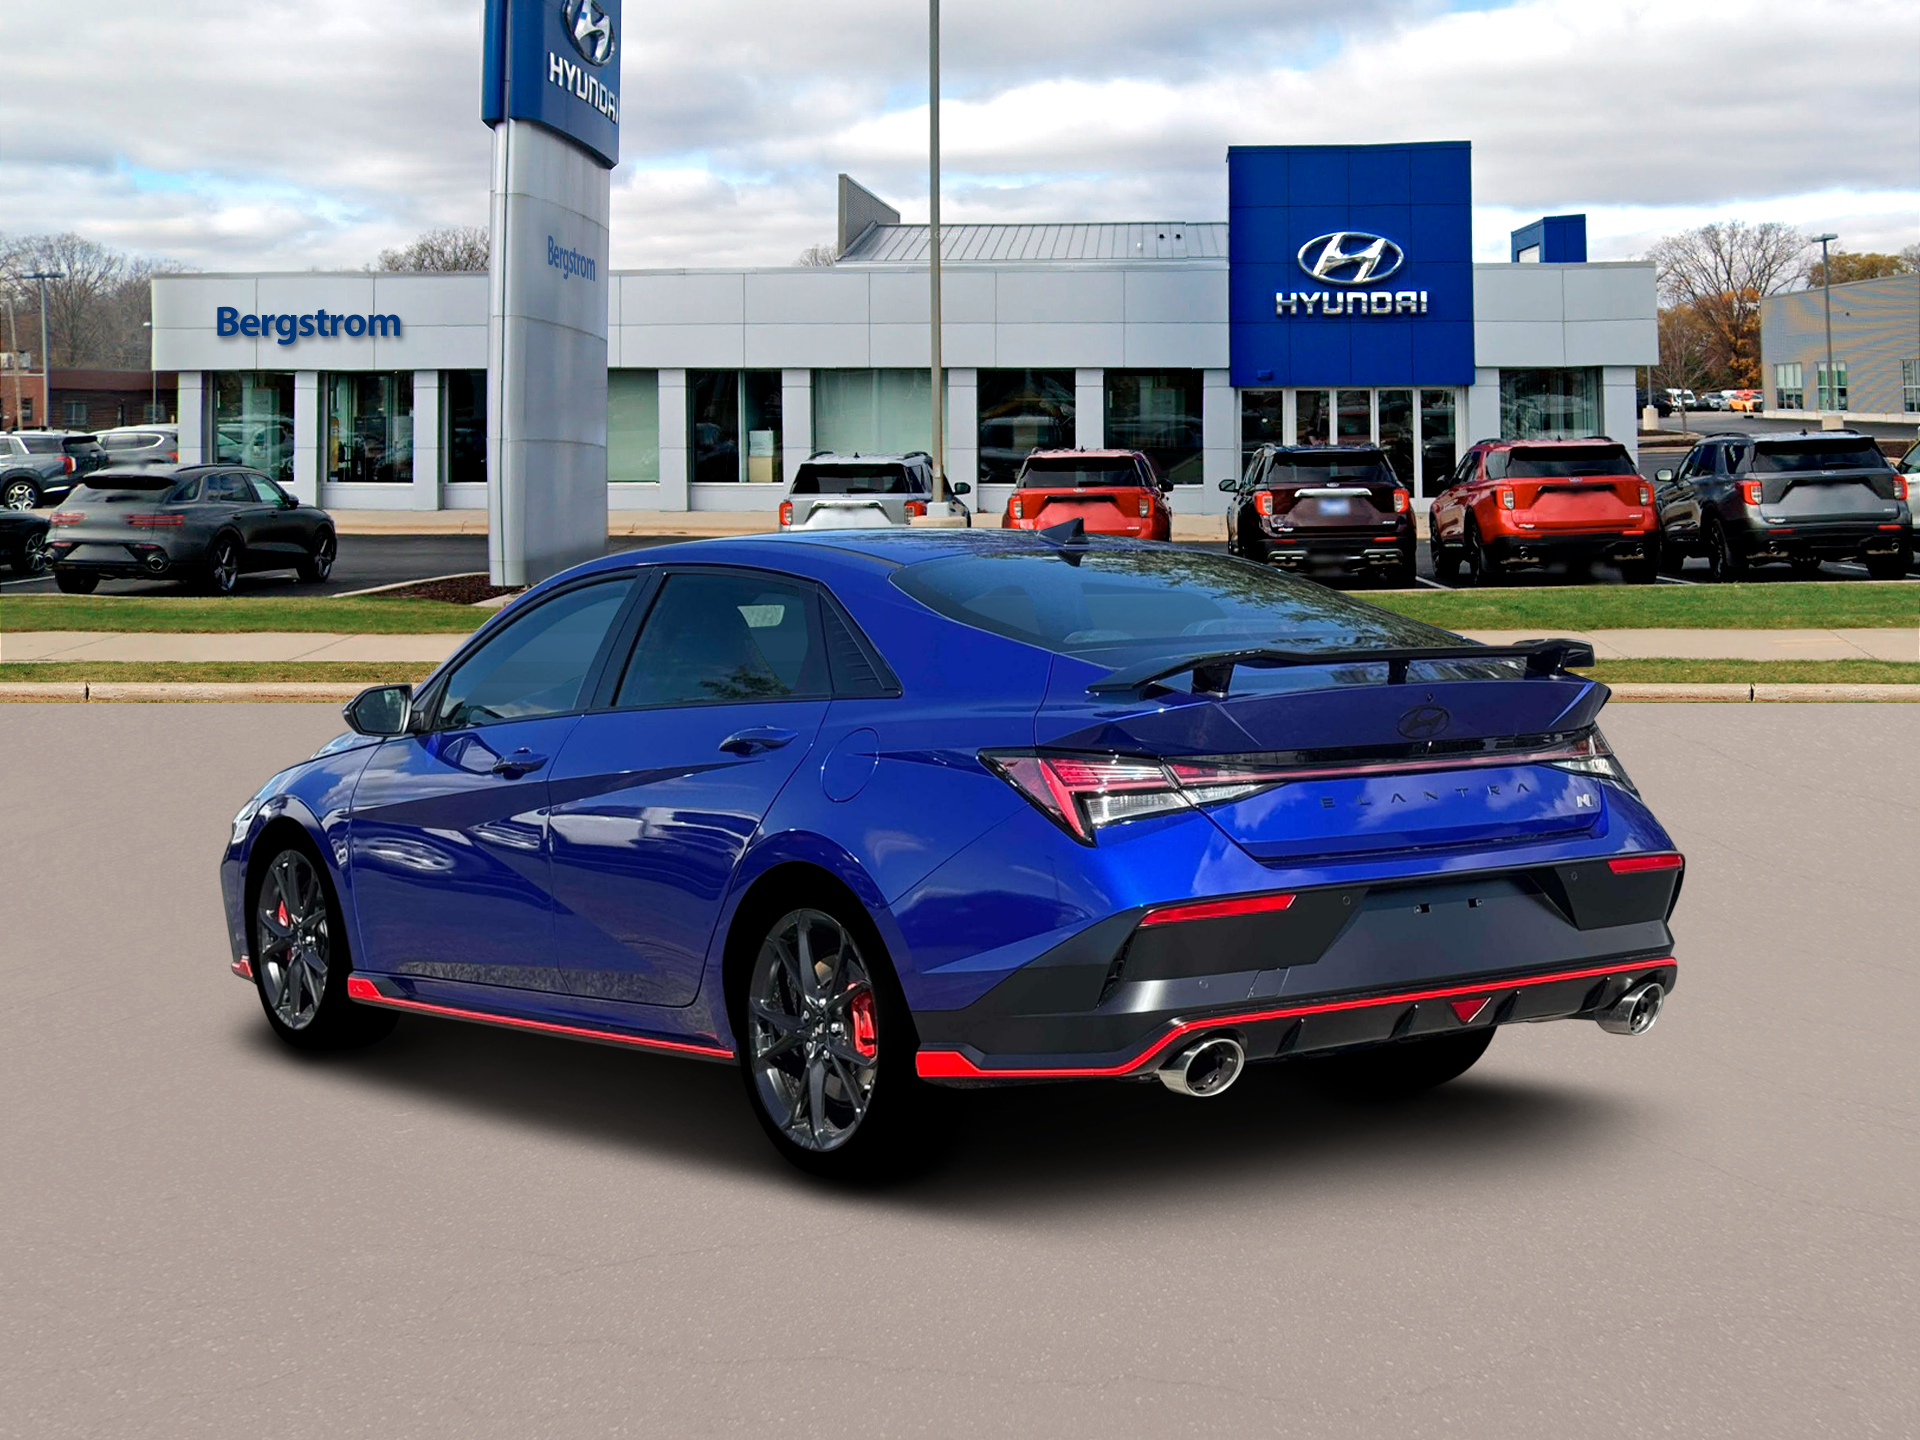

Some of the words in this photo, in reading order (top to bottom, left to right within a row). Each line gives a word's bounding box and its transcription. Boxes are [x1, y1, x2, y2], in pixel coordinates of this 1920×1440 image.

[549, 52, 619, 124] HYUNDAI
[547, 235, 596, 282] Bergstrom
[1276, 290, 1428, 315] HYUNDAI
[216, 306, 402, 346] Bergstrom
[1320, 782, 1531, 809] ELANTRA
[1576, 793, 1594, 808] N
